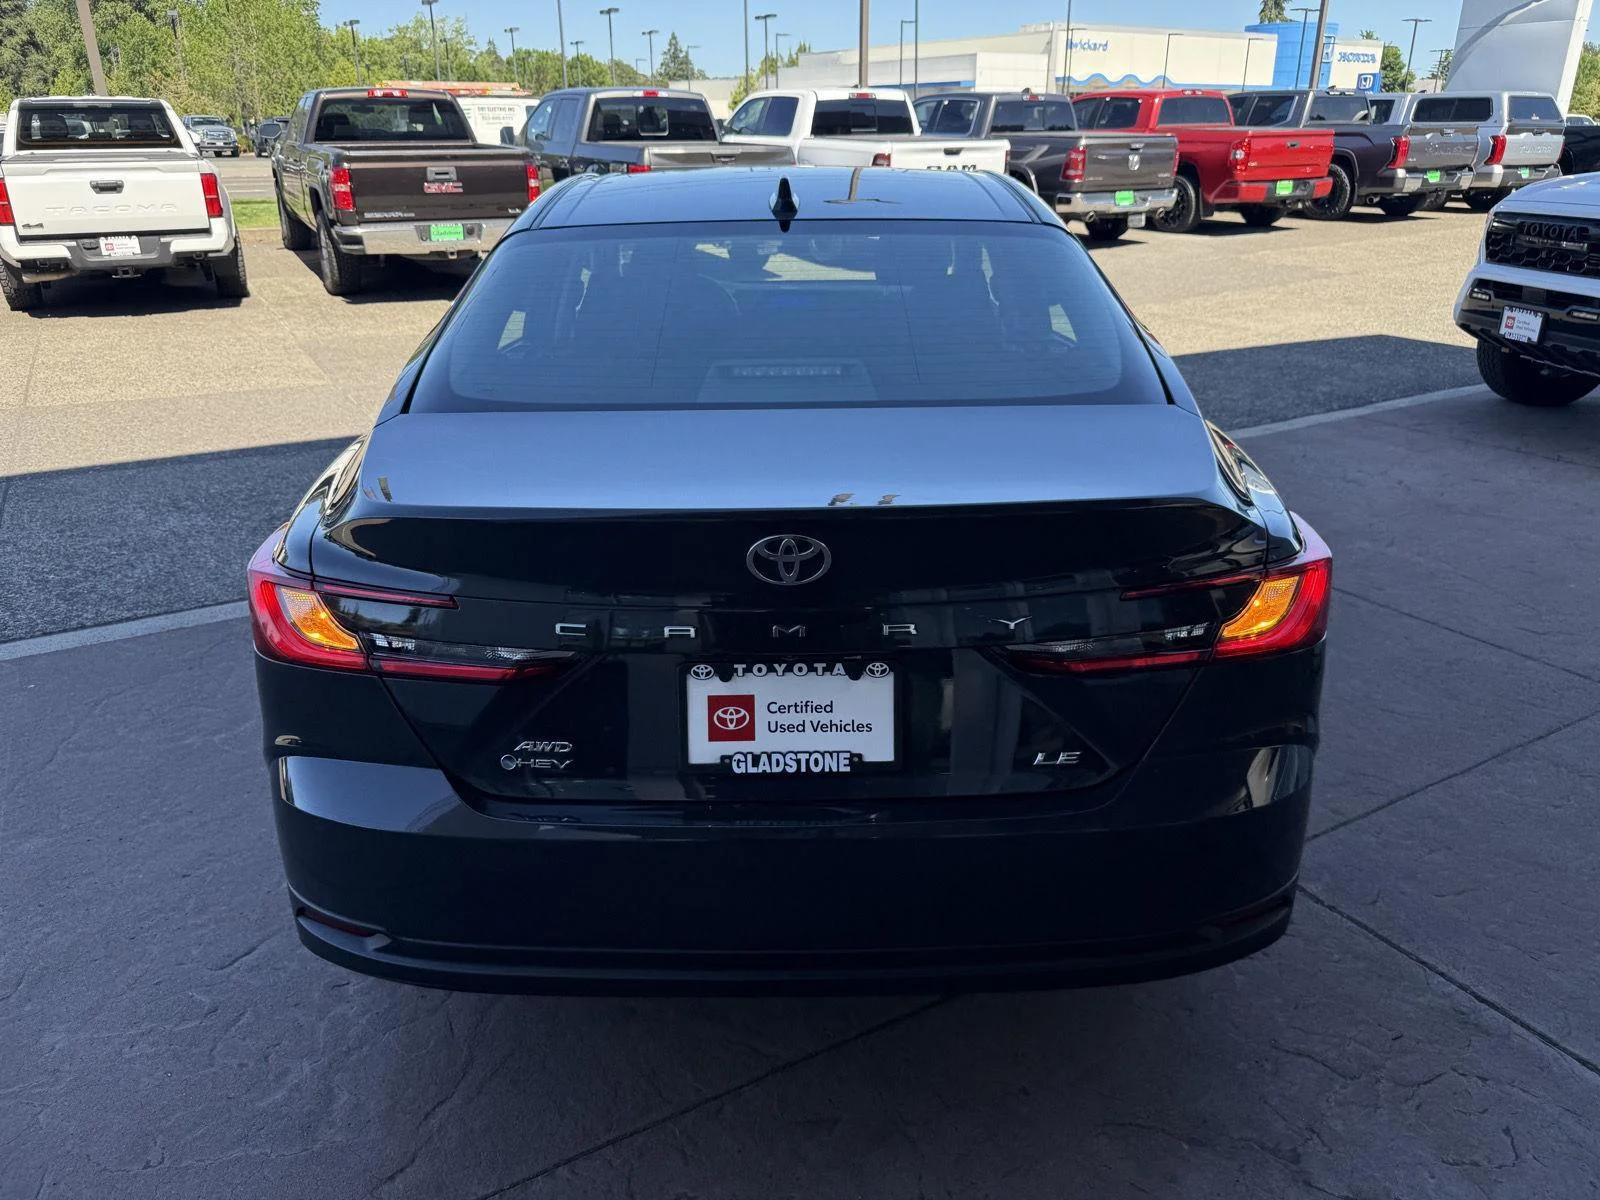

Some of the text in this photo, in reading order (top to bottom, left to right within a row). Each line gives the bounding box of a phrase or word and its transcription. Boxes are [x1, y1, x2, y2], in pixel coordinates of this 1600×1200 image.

[423, 182, 464, 193] GMC
[45, 203, 179, 217] TACOMA
[1523, 222, 1579, 241] TOYOTA
[555, 615, 1033, 639] CAMRY
[733, 662, 846, 677] TOYOTA
[767, 700, 834, 714] Certified
[767, 719, 873, 733] Used Vehicles
[513, 740, 573, 752] AWD
[516, 758, 573, 768] HEV
[731, 751, 851, 774] GLADSTONE
[1033, 751, 1082, 766] LE
